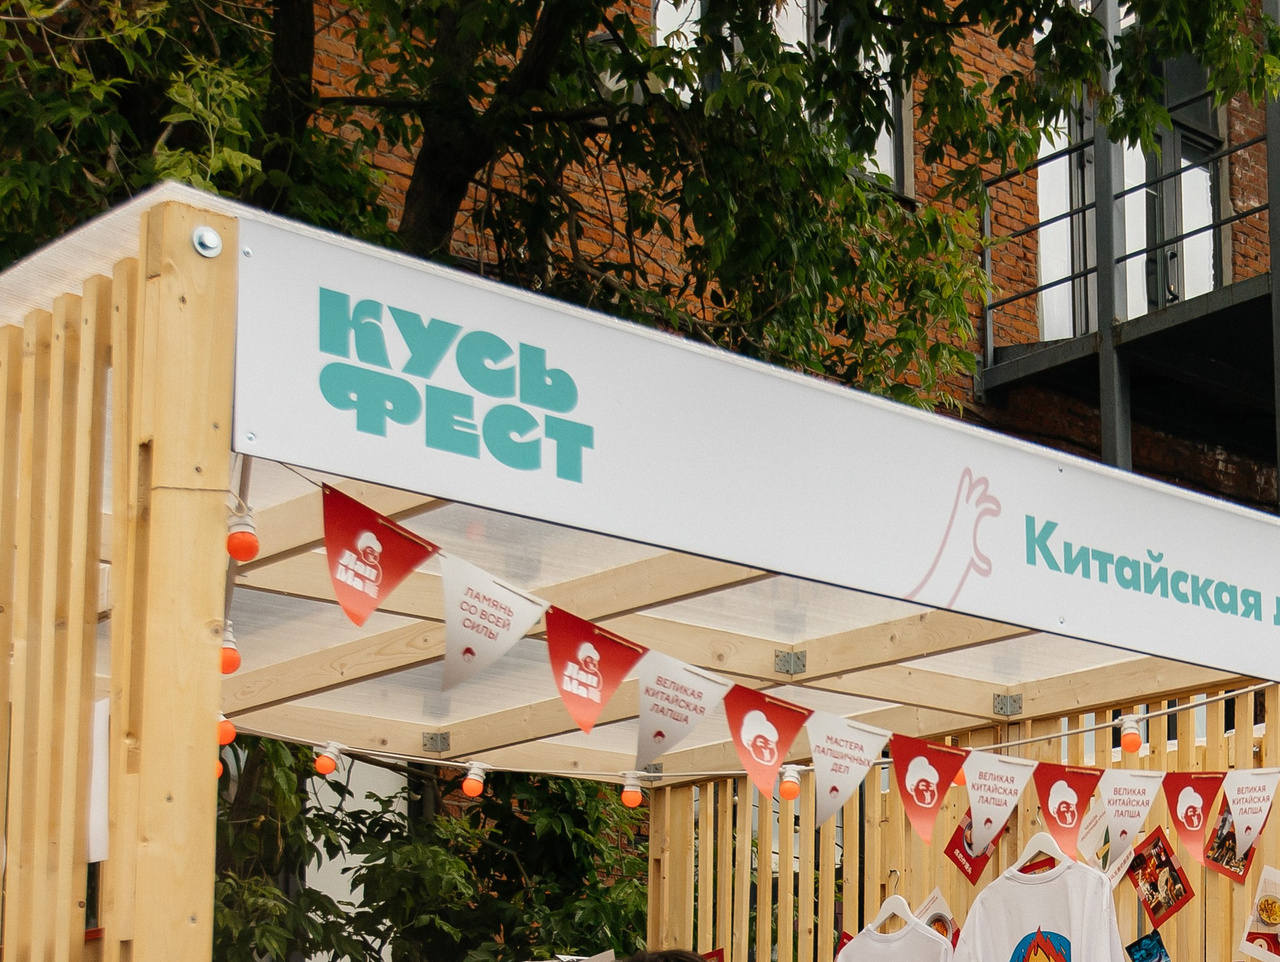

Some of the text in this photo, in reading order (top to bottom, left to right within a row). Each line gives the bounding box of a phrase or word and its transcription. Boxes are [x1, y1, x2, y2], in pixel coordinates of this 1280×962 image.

[319, 287, 578, 413] КУСЬ
[319, 362, 594, 483] ФЕСТ
[1025, 514, 1262, 621] Китайская
[463, 586, 514, 618] ЛАМЯНЬ
[460, 601, 511, 631] СО ВСЕЙ
[462, 618, 499, 642] СИЛЫ
[656, 675, 703, 700] ВЕЛИКАЯ
[644, 686, 706, 717] КИТАЙСКАЯ
[650, 703, 689, 725] ЛАПША
[825, 735, 865, 753] МАСТЕРА
[813, 744, 872, 768] ЛАПШИЧНЫХ
[831, 762, 850, 775] ДЕЛ
[978, 771, 1015, 784] ВЕЛИКАЯ
[970, 781, 1018, 797] КИТАЙСКАЯ
[1113, 787, 1146, 797] ВЕЛИКАЯ
[1236, 785, 1266, 794] ВЕЛИКАЯ
[977, 796, 1008, 807] ЛАПША
[1107, 797, 1150, 808] КИТАЙСКАЯ
[1231, 795, 1271, 806] КИТАЙСКАЯ
[1113, 809, 1141, 818] ЛАПША
[1238, 806, 1263, 815] ЛАПША
